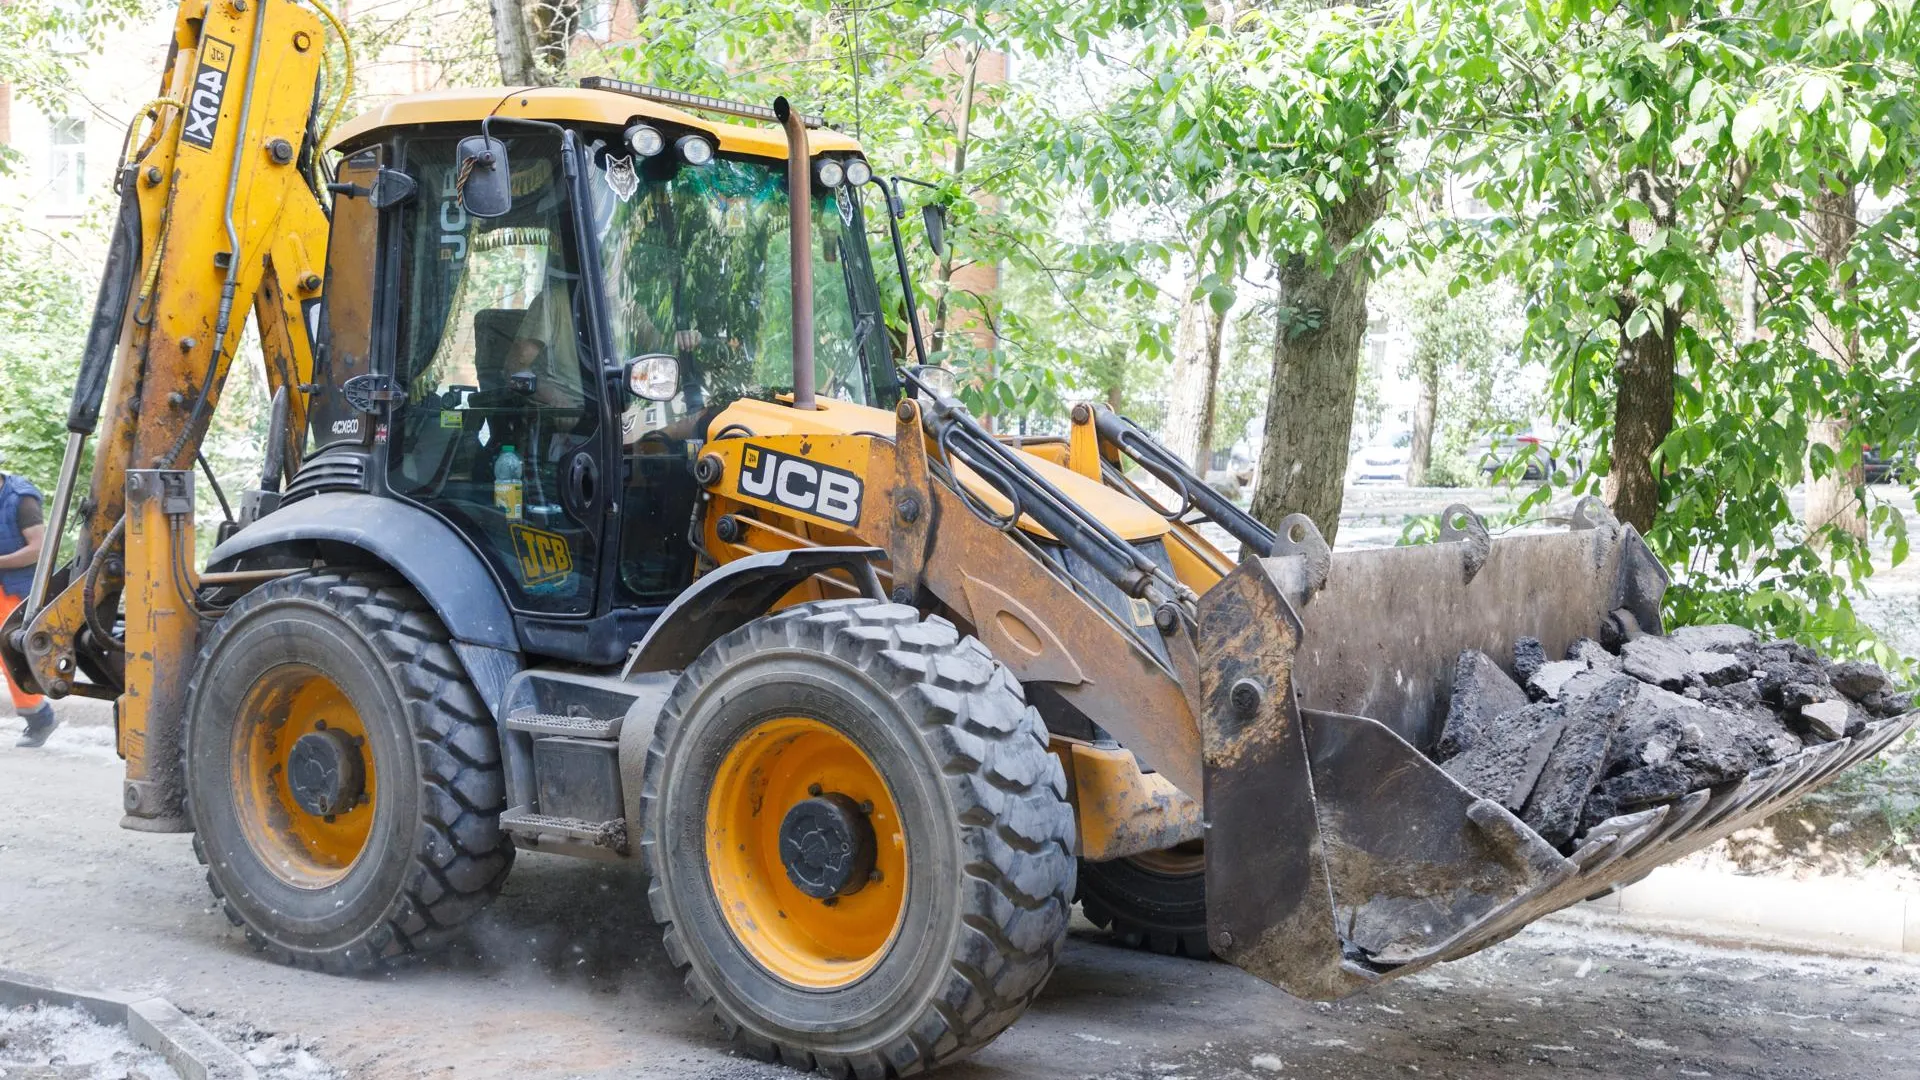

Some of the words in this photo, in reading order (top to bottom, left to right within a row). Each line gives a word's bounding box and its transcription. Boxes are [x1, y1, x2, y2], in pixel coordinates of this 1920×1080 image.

[185, 70, 223, 139] 4CX
[741, 453, 860, 522] JCB
[520, 531, 569, 578] JCB
